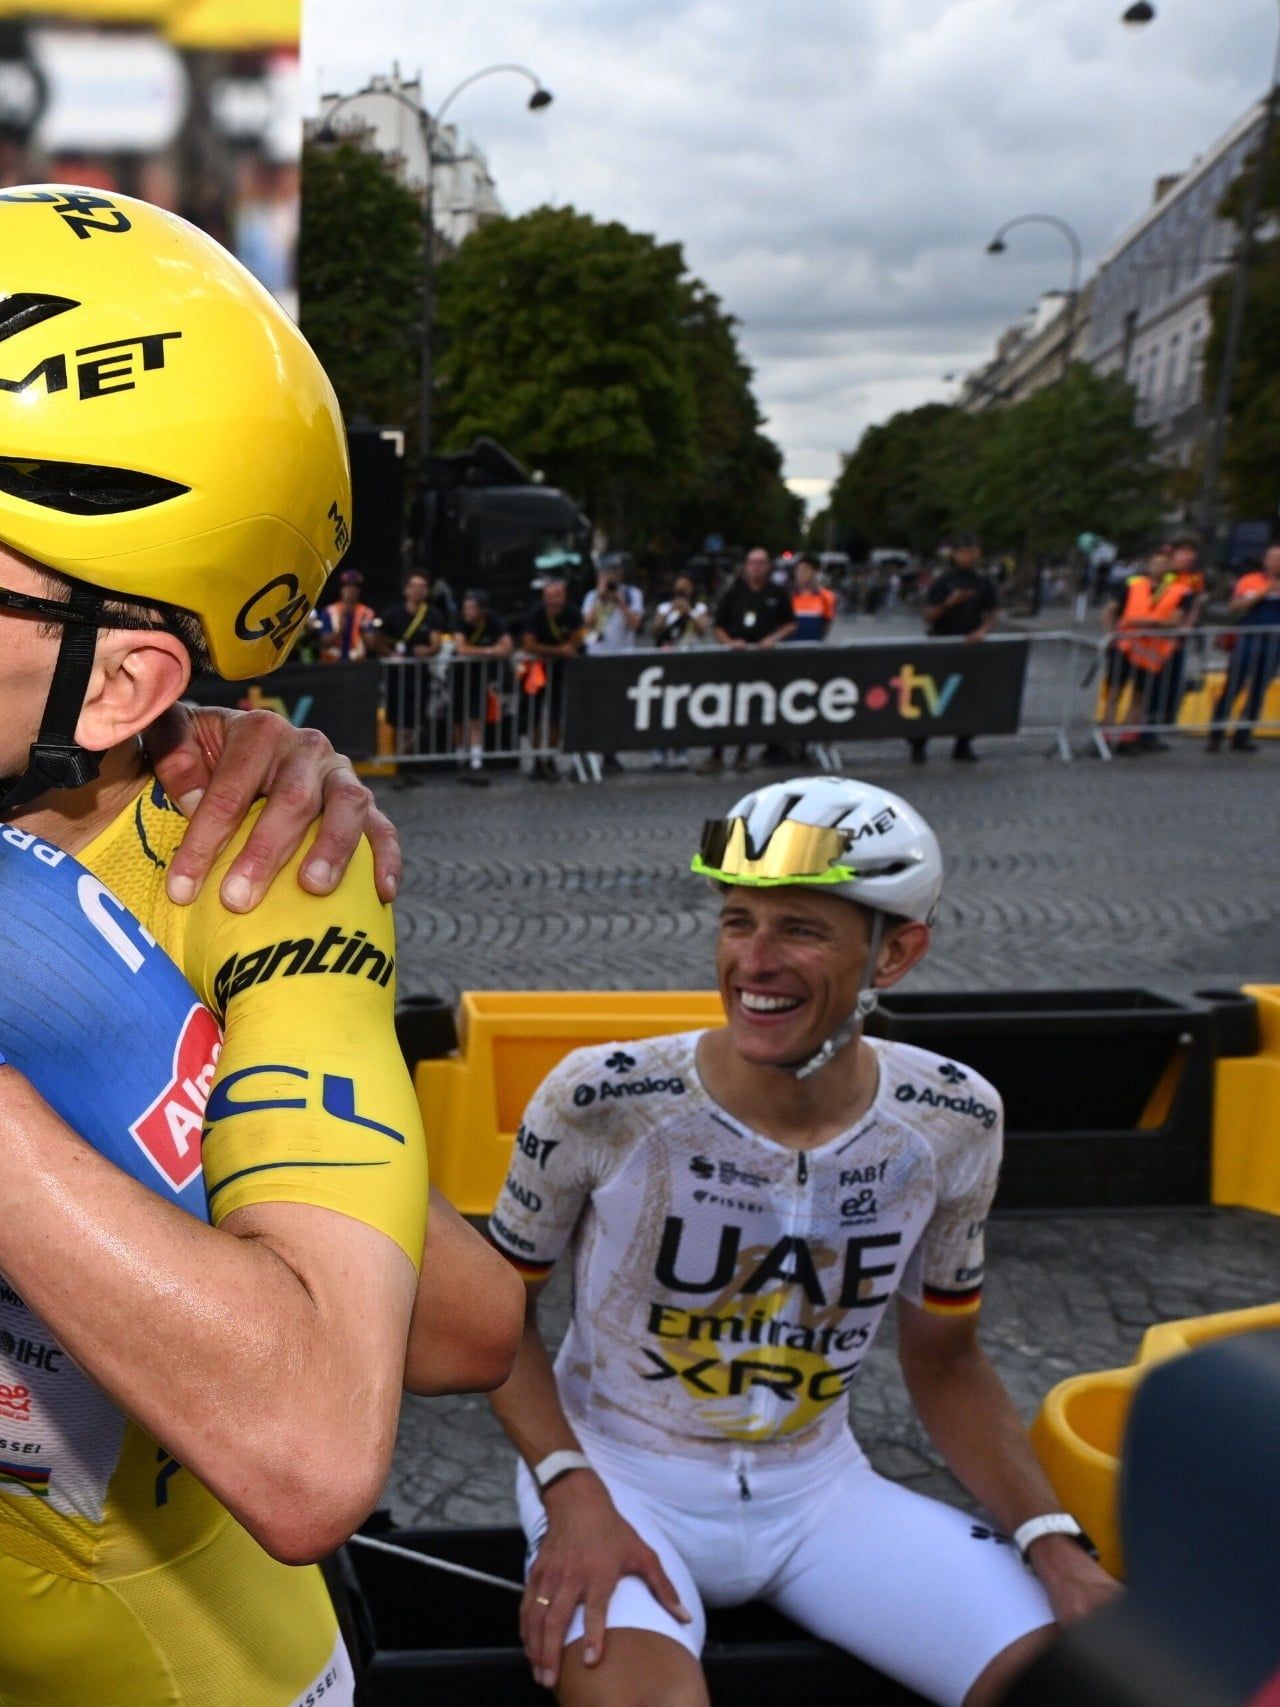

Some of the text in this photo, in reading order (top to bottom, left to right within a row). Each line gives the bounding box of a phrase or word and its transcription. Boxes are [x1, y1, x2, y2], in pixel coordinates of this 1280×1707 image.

[627, 666, 859, 731] france
[599, 1077, 685, 1100] Analog
[916, 1088, 998, 1130] Analog
[654, 1216, 902, 1308] UAE
[648, 1303, 871, 1355] Emirates
[17, 1339, 62, 1373] IHC
[299, 1668, 336, 1707] SSEI
